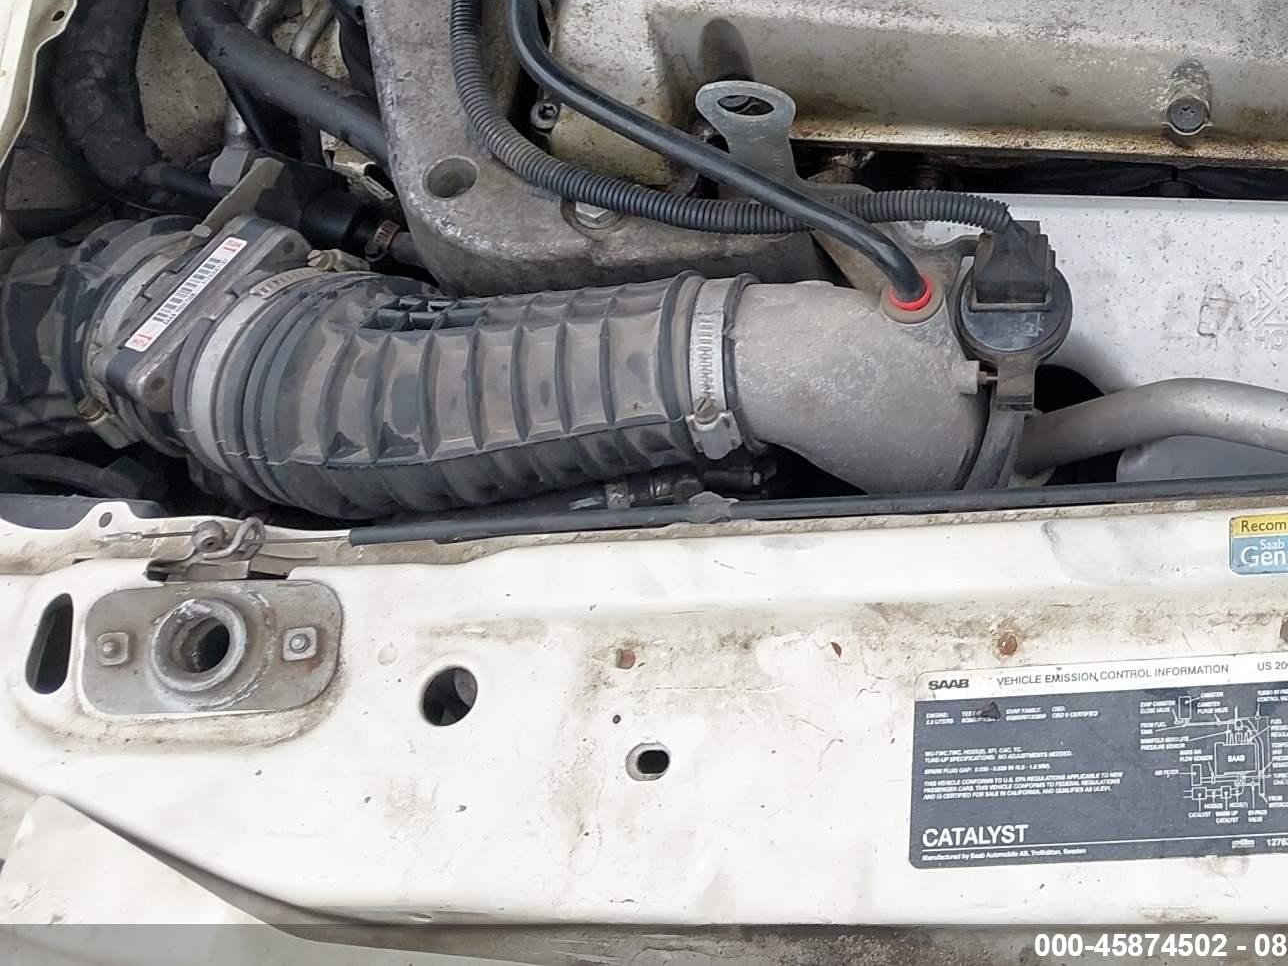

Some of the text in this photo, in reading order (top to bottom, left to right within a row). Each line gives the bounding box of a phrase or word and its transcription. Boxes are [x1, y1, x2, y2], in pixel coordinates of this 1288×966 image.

[1260, 538, 1285, 549] Saab
[928, 678, 969, 690] SAAB
[997, 675, 1041, 686] VEHICLE
[1100, 668, 1152, 681] CONTROL
[1155, 664, 1229, 677] INFORMATION
[1257, 662, 1273, 671] US
[922, 824, 1029, 847] CATALYST
[961, 853, 970, 861] by
